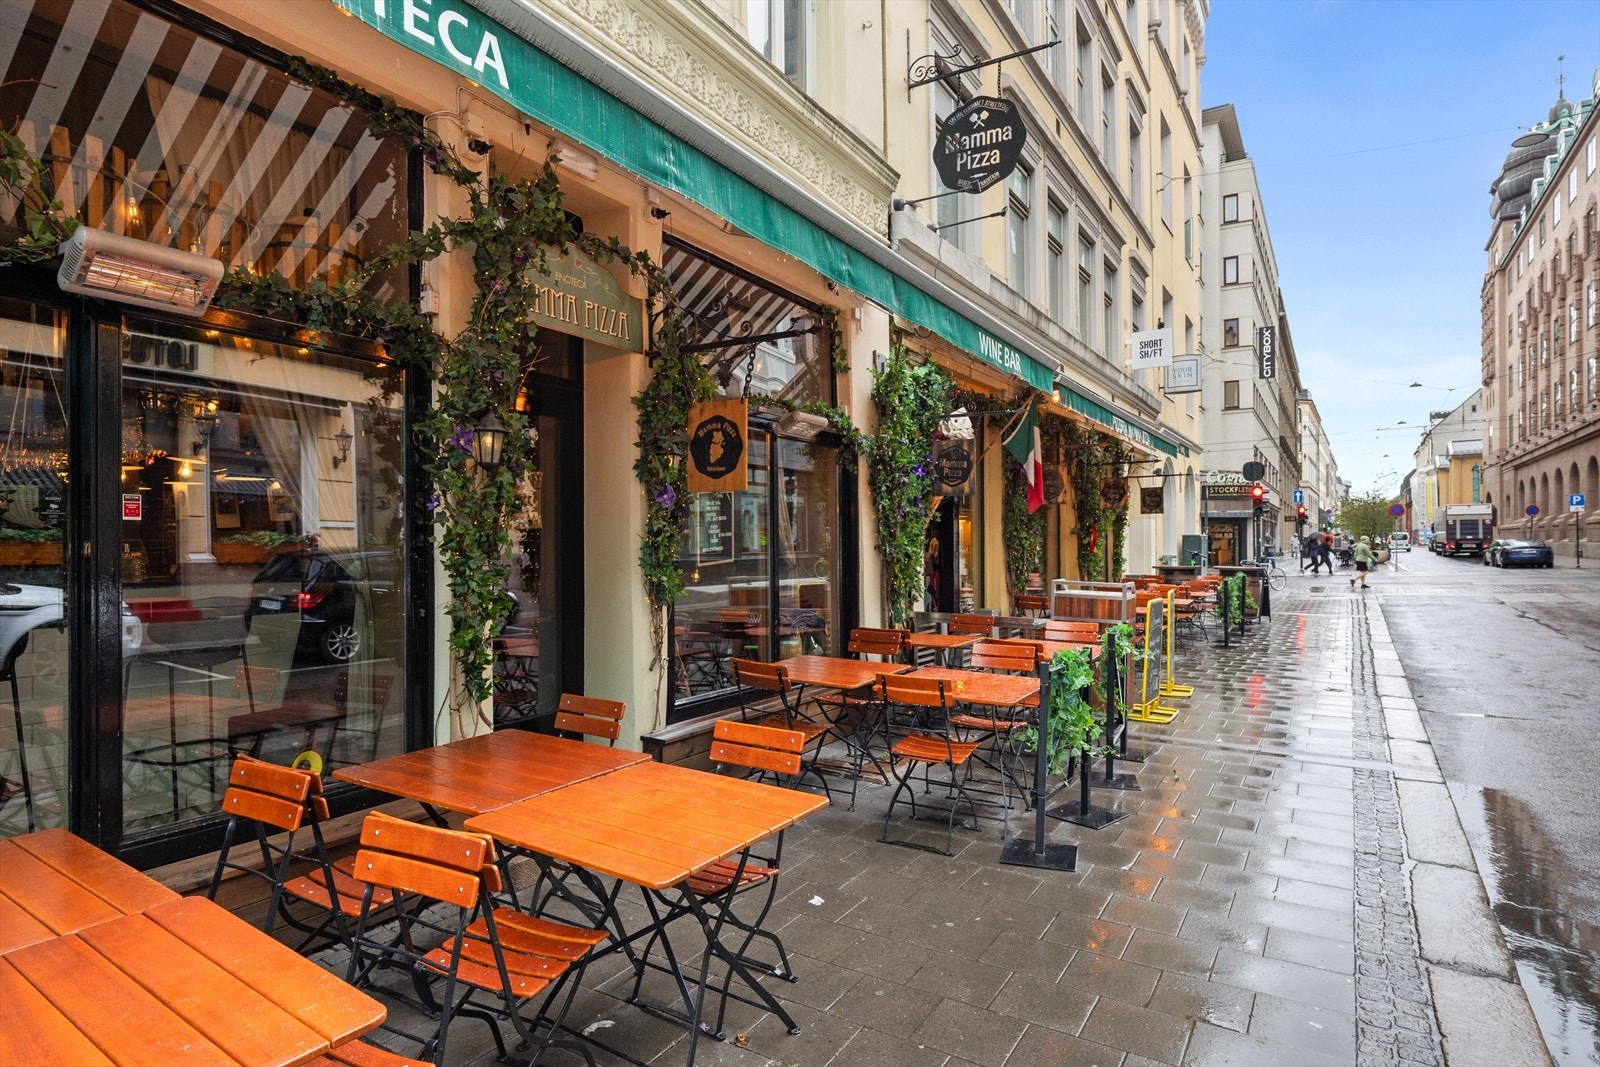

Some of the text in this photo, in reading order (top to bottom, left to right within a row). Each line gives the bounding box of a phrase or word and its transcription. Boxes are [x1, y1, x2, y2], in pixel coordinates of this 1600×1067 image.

[956, 149, 1001, 172] Pizza
[555, 271, 587, 290] ENOTECA
[584, 300, 631, 340] PIZZA
[1139, 338, 1163, 350] SHORT
[978, 331, 1022, 373] WINE BAR
[1139, 347, 1163, 360] SH/FT
[1172, 366, 1193, 374] YOUR
[1172, 372, 1193, 380] SKIN
[1572, 495, 1582, 505] P
